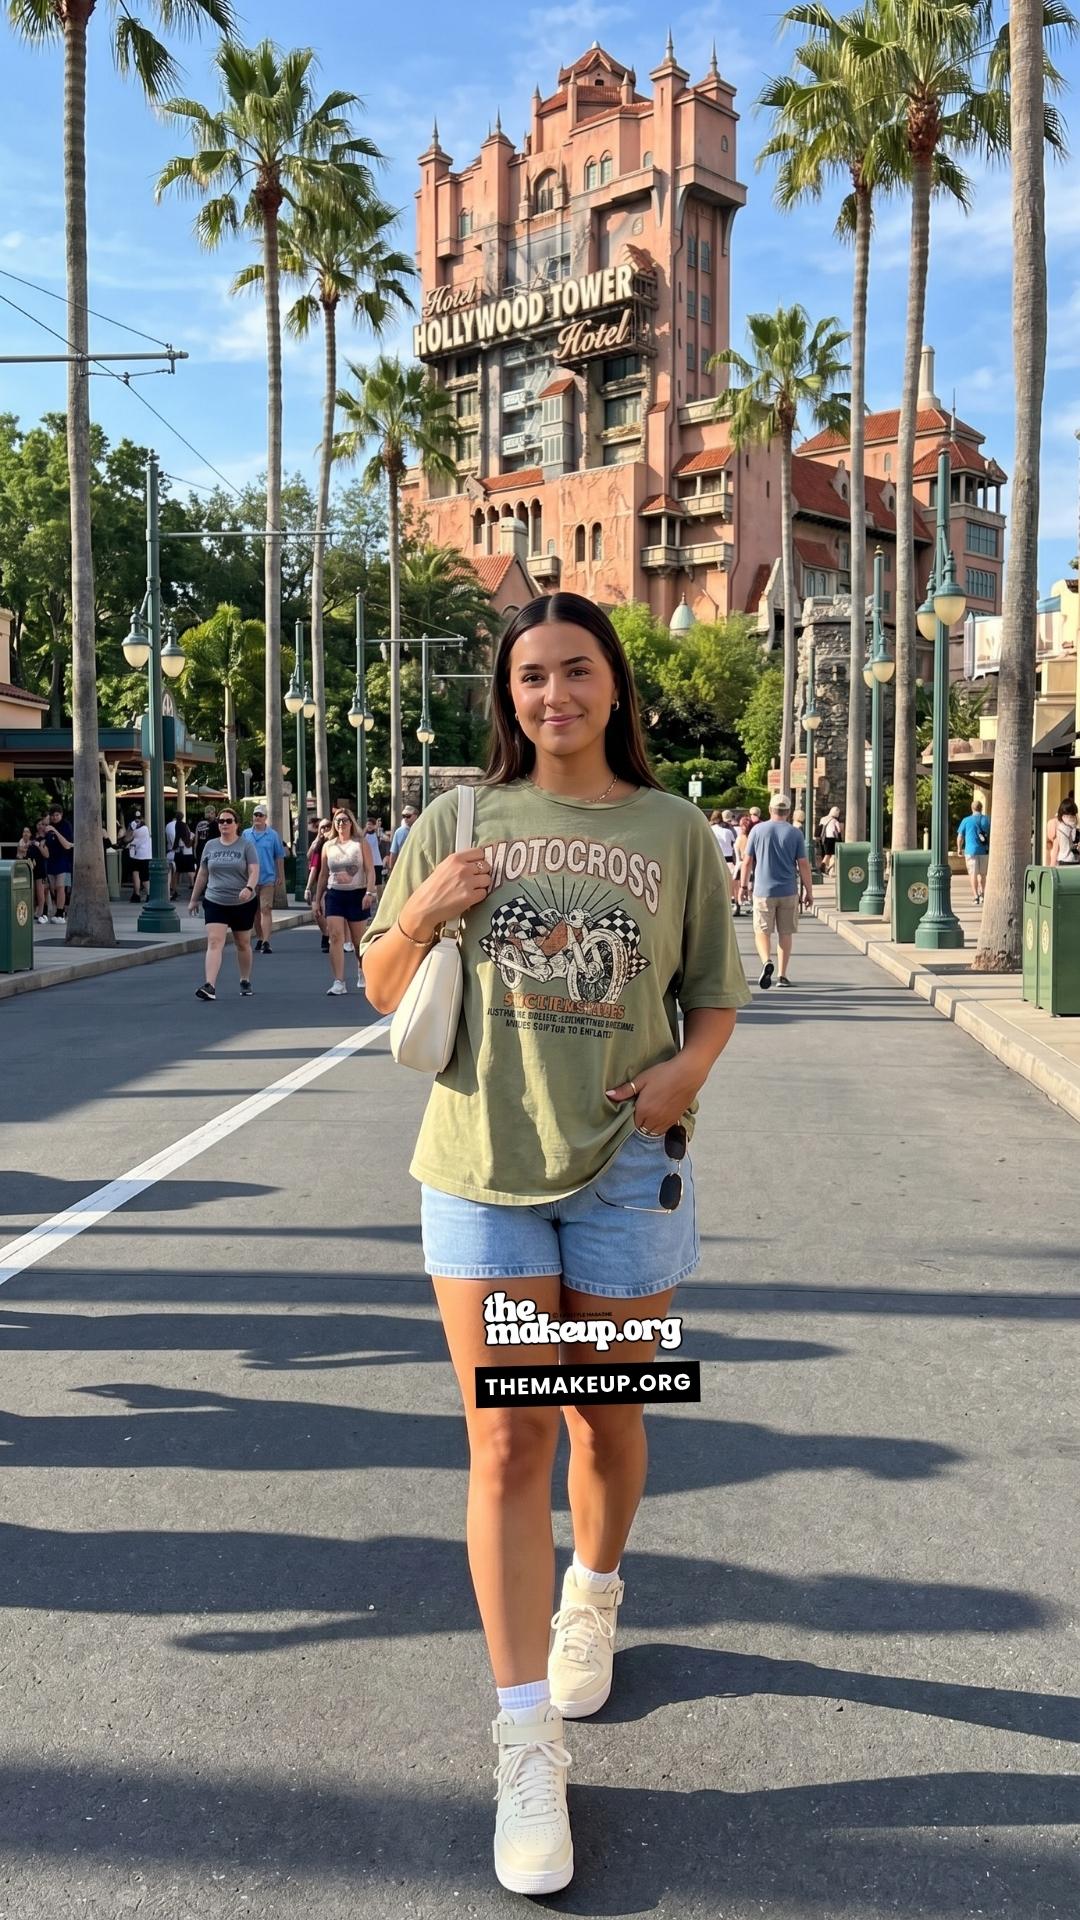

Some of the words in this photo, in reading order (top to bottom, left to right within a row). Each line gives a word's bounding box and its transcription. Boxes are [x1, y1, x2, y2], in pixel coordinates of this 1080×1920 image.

[413, 291, 545, 357] HOLLYWOOD
[550, 263, 635, 319] TOWER
[423, 279, 477, 317] Hotel
[552, 308, 632, 359] Hotel
[484, 837, 662, 915] MOTOCROSS
